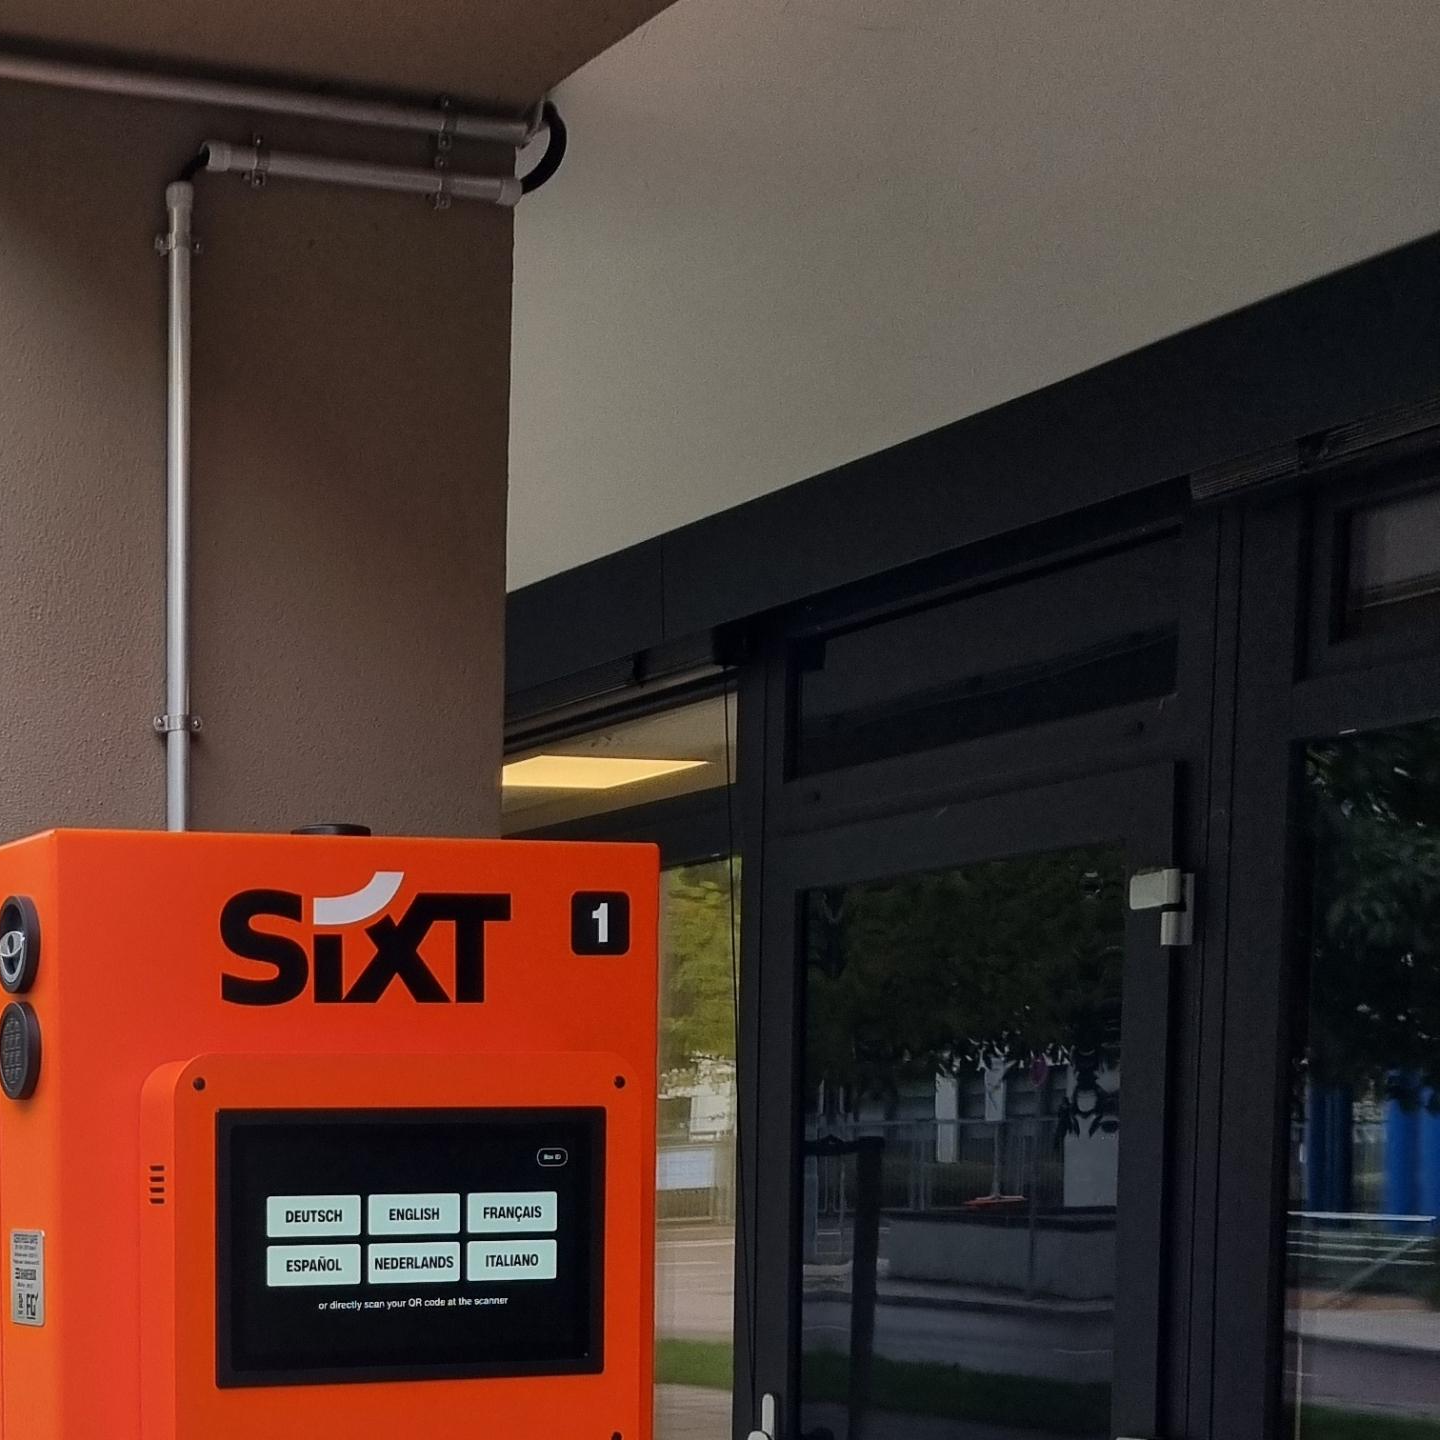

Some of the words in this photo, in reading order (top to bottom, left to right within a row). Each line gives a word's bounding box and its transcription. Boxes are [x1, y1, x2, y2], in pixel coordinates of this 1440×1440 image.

[591, 902, 609, 944] 1
[219, 872, 512, 1007] SIXT
[285, 1209, 343, 1224] DEUTSCH
[388, 1207, 440, 1222] ENGLISH
[483, 1205, 542, 1222] FRANÇAIS
[286, 1256, 342, 1272] ESPAÑOL
[374, 1255, 454, 1270] NEDERLANDS
[485, 1253, 539, 1268] ITALIANO
[318, 1302, 328, 1310] or
[329, 1300, 362, 1311] directly
[364, 1301, 385, 1309] scan
[386, 1301, 406, 1311] your
[424, 1297, 446, 1307] code
[447, 1298, 456, 1306] at
[458, 1297, 472, 1306] the
[474, 1297, 509, 1306] scanner
